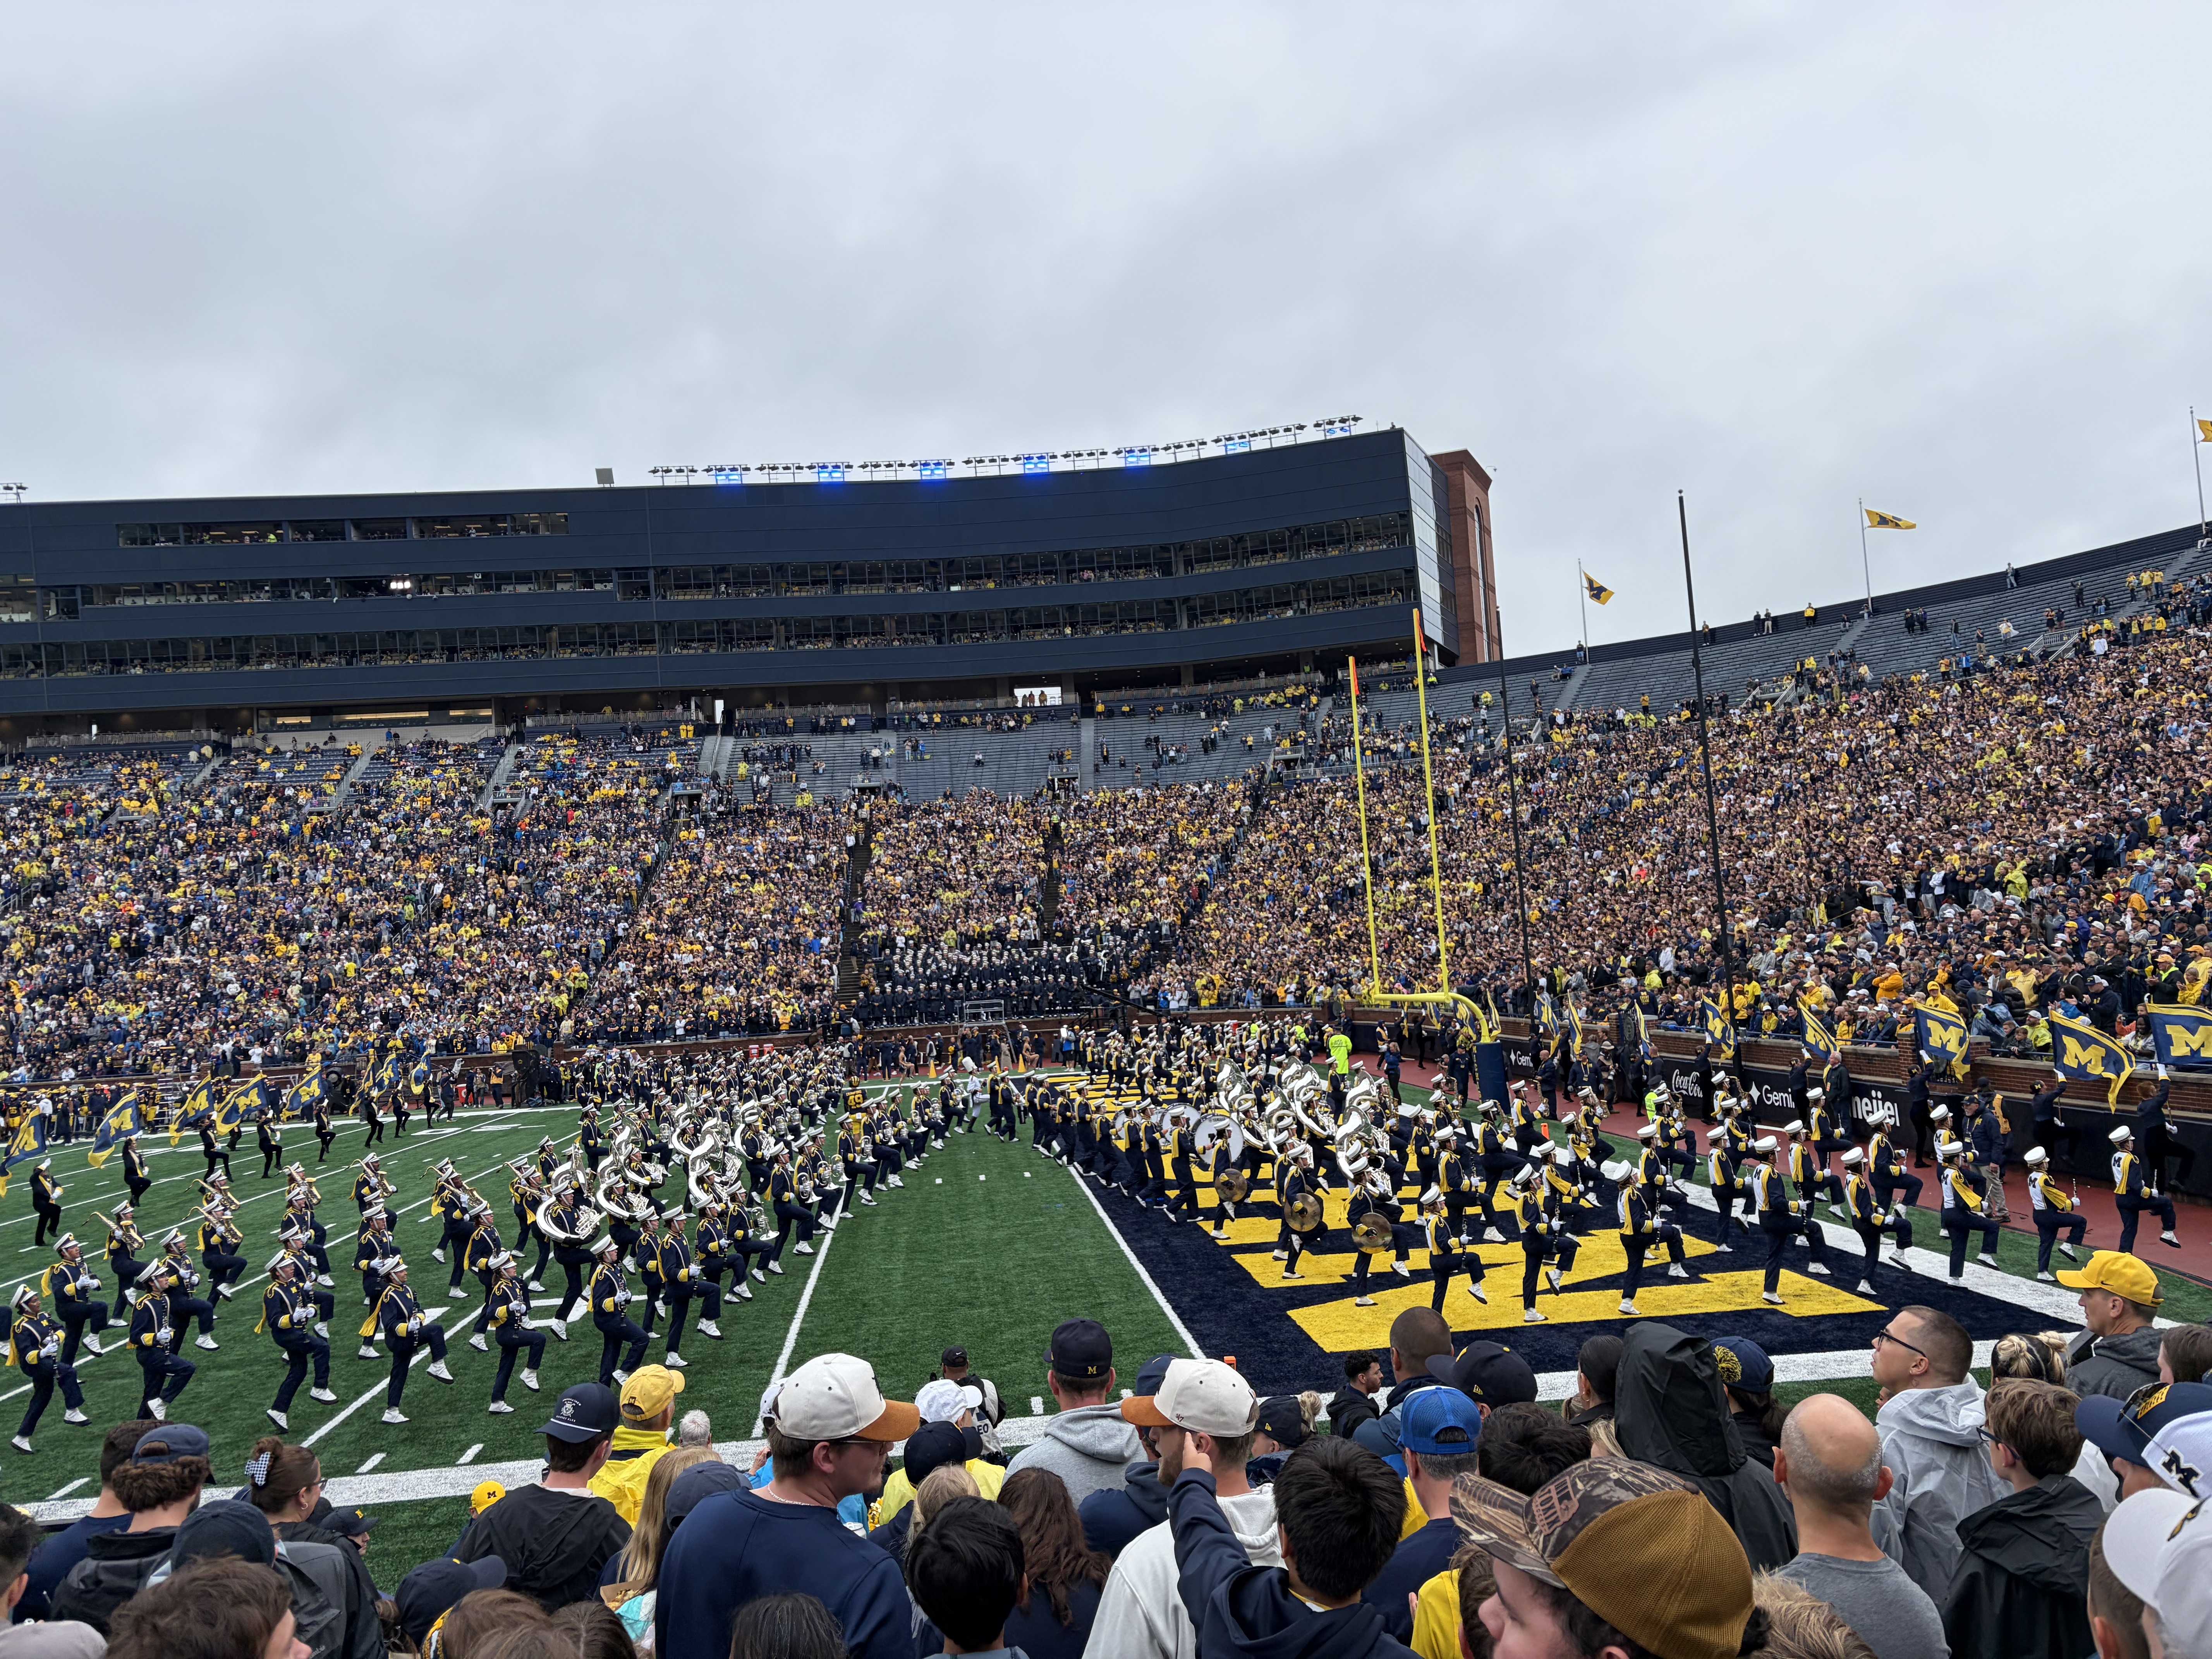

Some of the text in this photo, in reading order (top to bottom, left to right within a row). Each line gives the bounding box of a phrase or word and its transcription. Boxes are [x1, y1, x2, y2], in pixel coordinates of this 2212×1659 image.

[1926, 1019, 1964, 1054] M
[2165, 1025, 2212, 1057] M
[1516, 1051, 1533, 1067] Gemi
[2062, 1035, 2106, 1075] M
[235, 1087, 262, 1114] M
[299, 1079, 321, 1103] M
[1762, 1085, 1795, 1108] Gemi
[186, 1089, 209, 1118] M
[847, 1094, 863, 1109] 49
[109, 1108, 133, 1137] M
[1934, 1133, 1942, 1143] M
[2113, 1156, 2123, 1168] M
[1754, 1168, 1762, 1180] M
[2029, 1176, 2038, 1188] M
[1087, 1366, 1097, 1374] M
[486, 1491, 497, 1499] M
